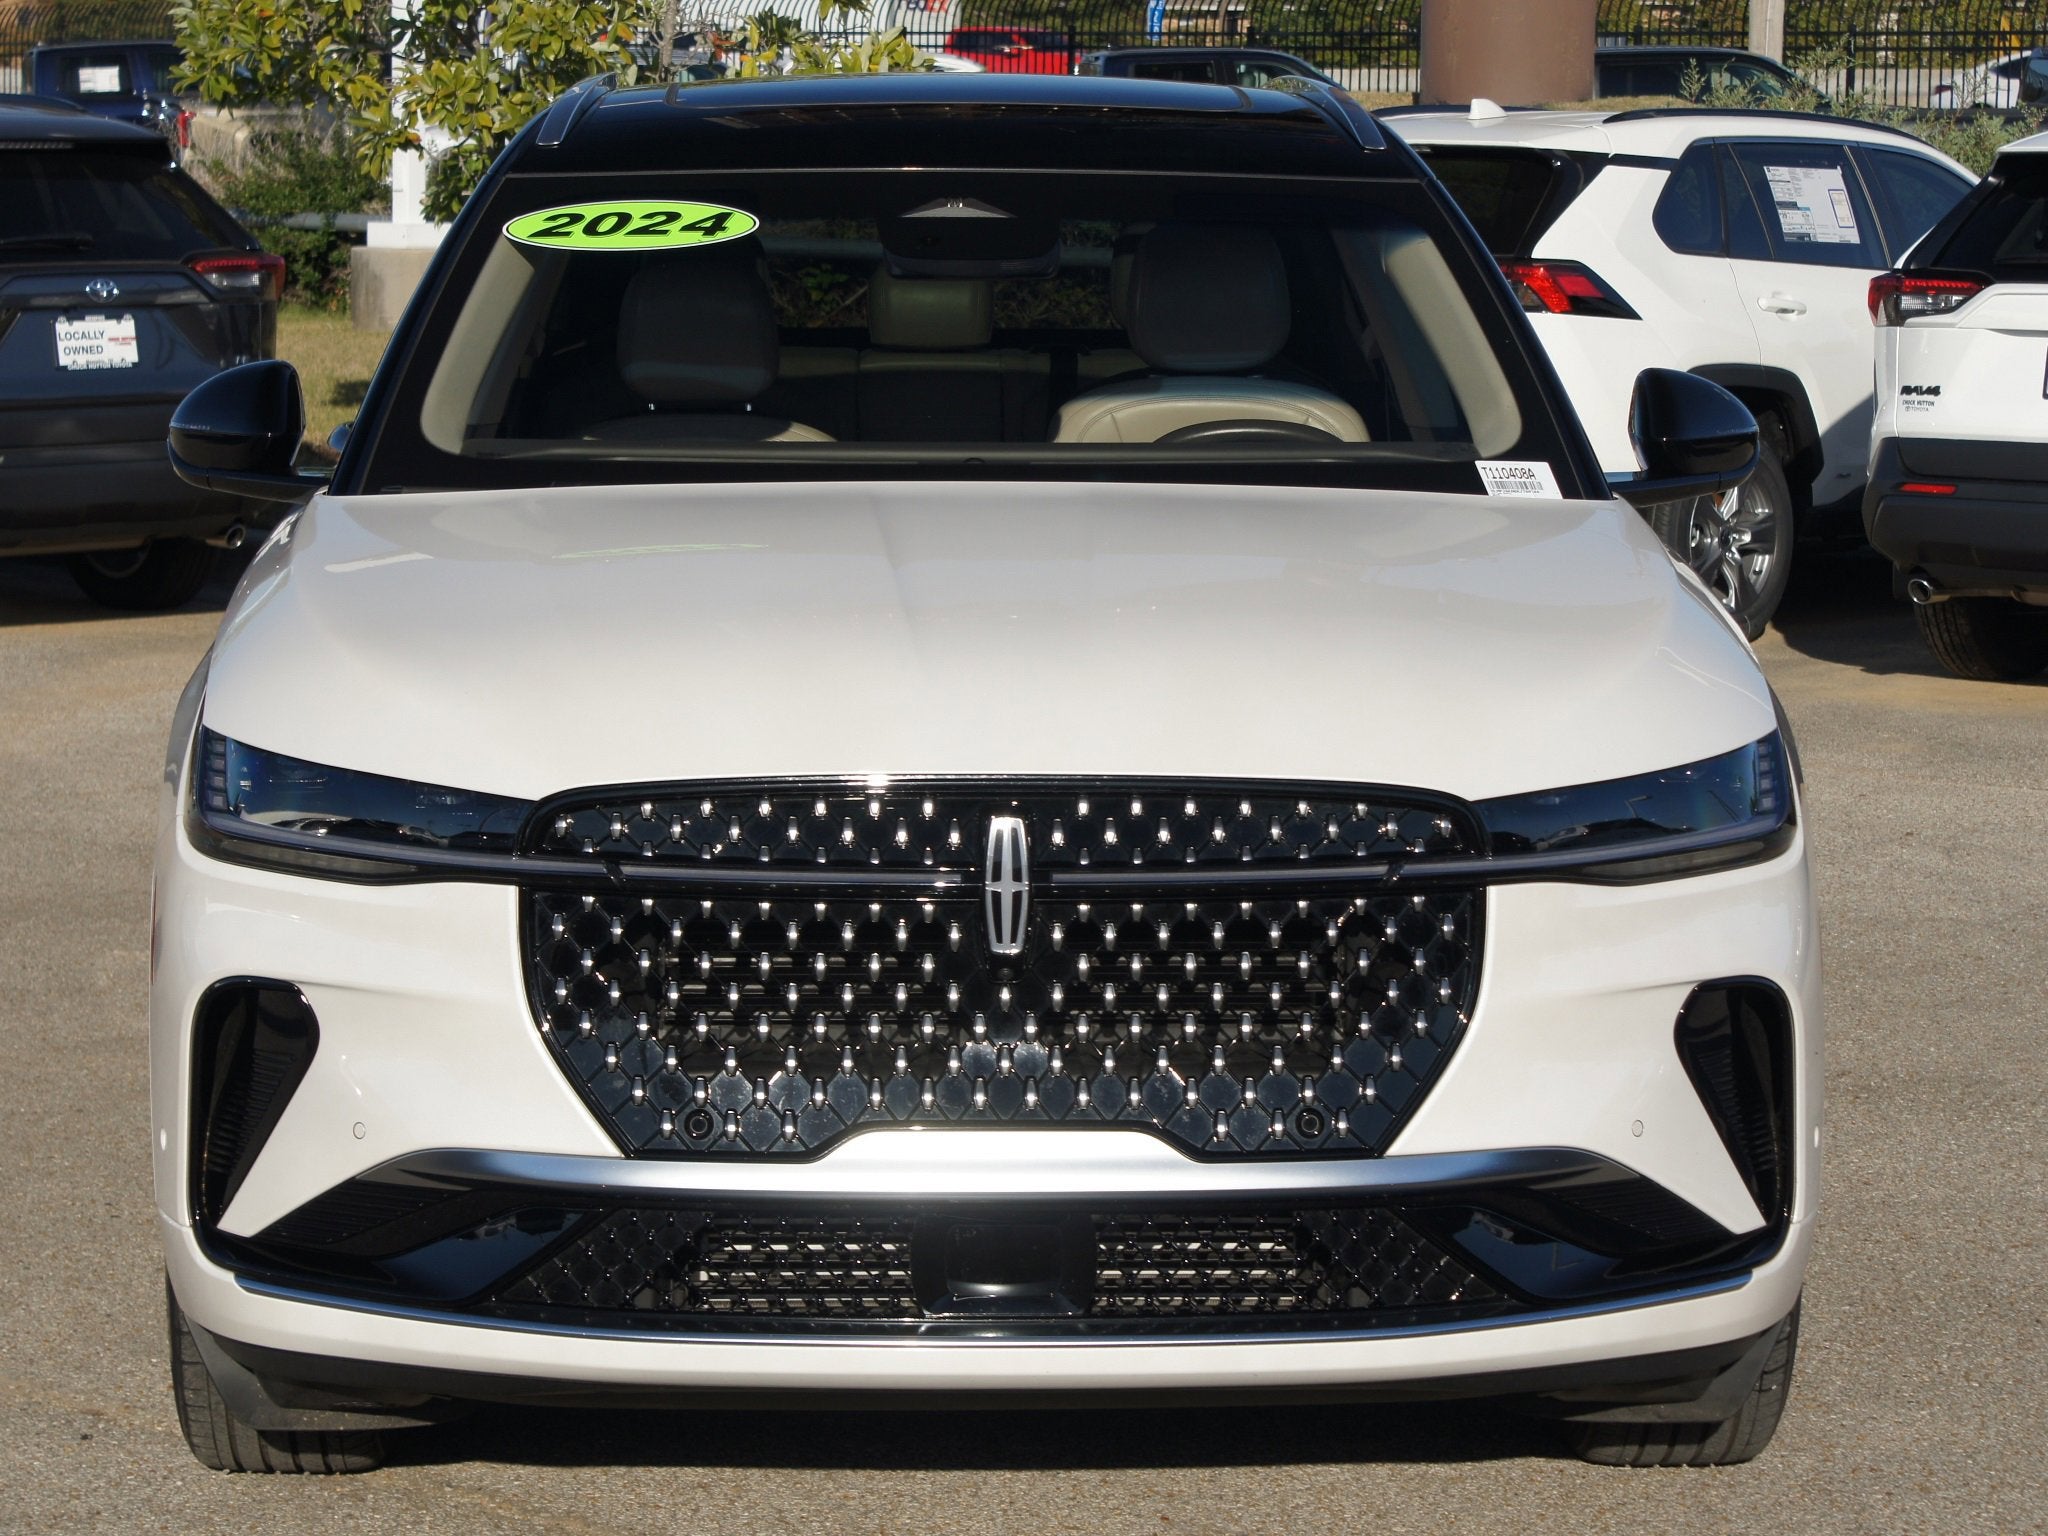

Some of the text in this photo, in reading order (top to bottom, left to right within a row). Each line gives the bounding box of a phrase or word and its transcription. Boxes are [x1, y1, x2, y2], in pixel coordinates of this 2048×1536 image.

[527, 211, 735, 238] 2024
[59, 331, 105, 342] LOCALLY
[64, 345, 104, 356] OWNED
[1481, 466, 1537, 480] T110408A
